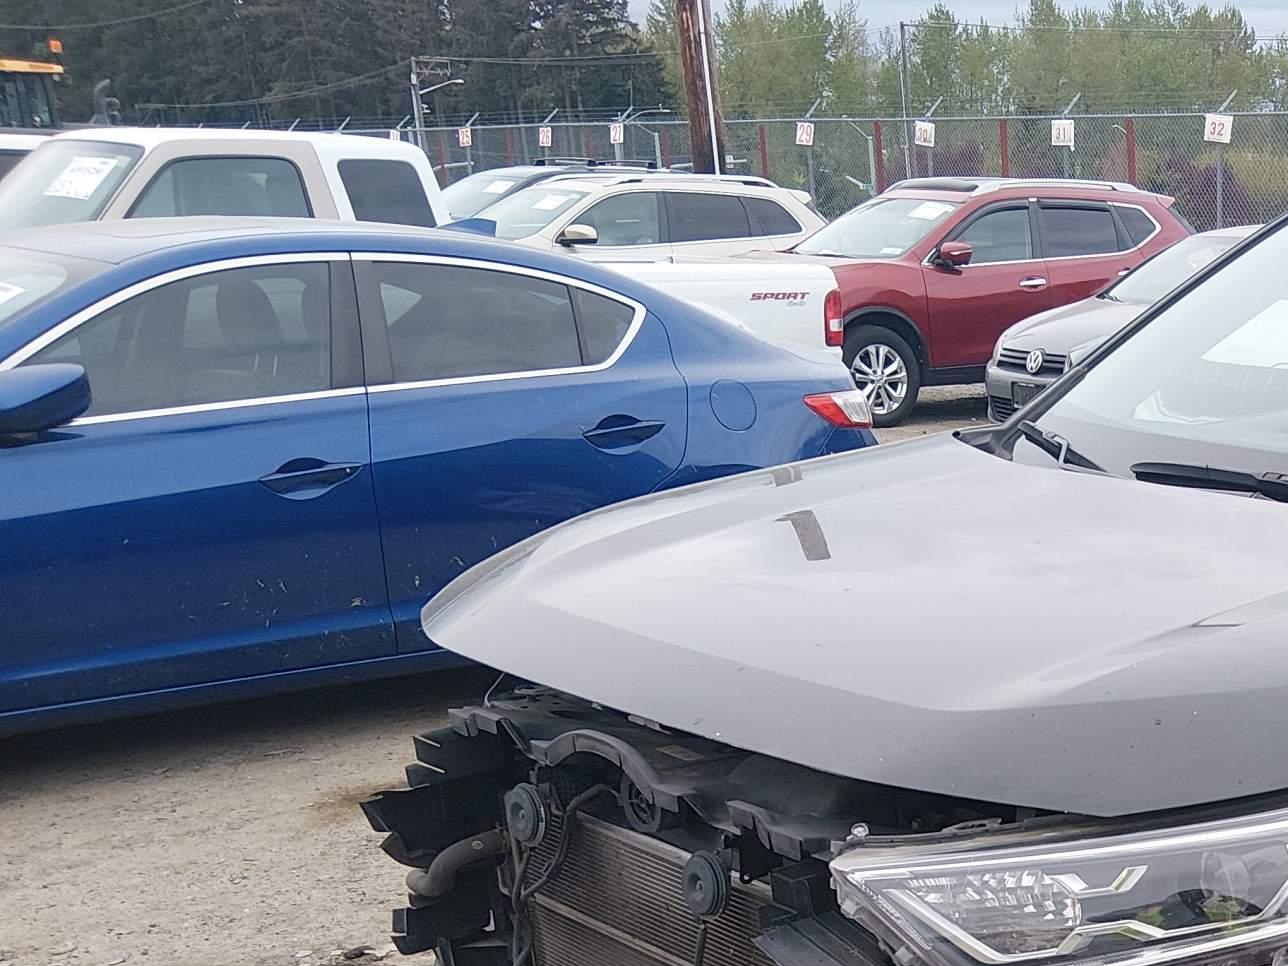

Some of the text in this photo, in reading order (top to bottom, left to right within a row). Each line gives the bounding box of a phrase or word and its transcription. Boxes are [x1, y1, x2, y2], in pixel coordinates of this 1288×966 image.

[612, 125, 622, 142] 27
[799, 124, 813, 144] 29
[917, 127, 929, 141] 30
[1055, 127, 1066, 140] 31
[1209, 121, 1225, 137] 32
[461, 130, 470, 145] 25
[540, 129, 550, 145] 26
[750, 292, 810, 301] SPORT
